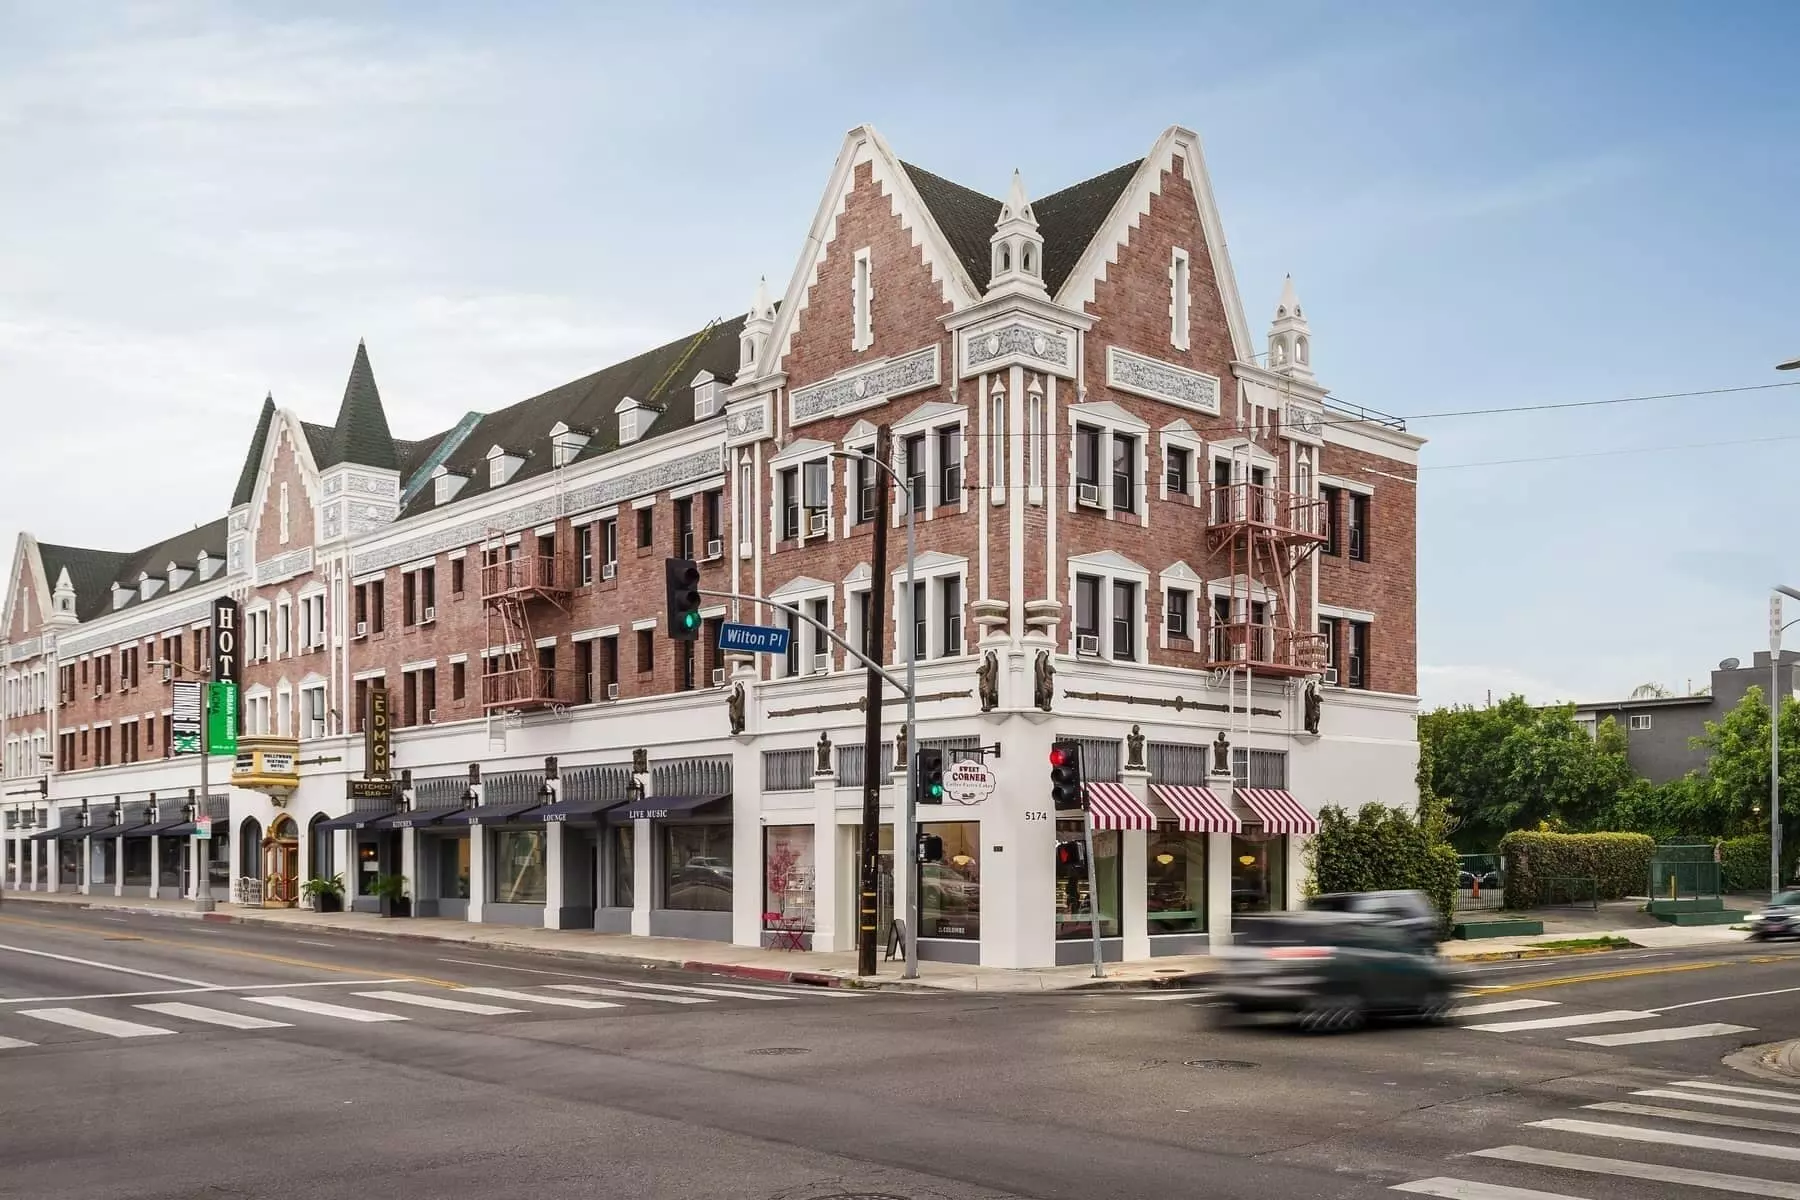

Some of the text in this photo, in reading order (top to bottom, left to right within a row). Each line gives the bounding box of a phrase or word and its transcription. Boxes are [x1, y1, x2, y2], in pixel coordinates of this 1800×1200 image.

[218, 607, 234, 684] HOT
[728, 629, 782, 647] Wilton Pl
[173, 682, 200, 721] THINKING
[212, 686, 220, 715] LACMA
[226, 686, 234, 715] BARBARA
[173, 722, 200, 734] OF
[952, 772, 986, 782] CORNER
[543, 814, 567, 822] LOUNGE
[629, 809, 668, 819] LIVE MUSIC
[1025, 811, 1046, 821] 5174
